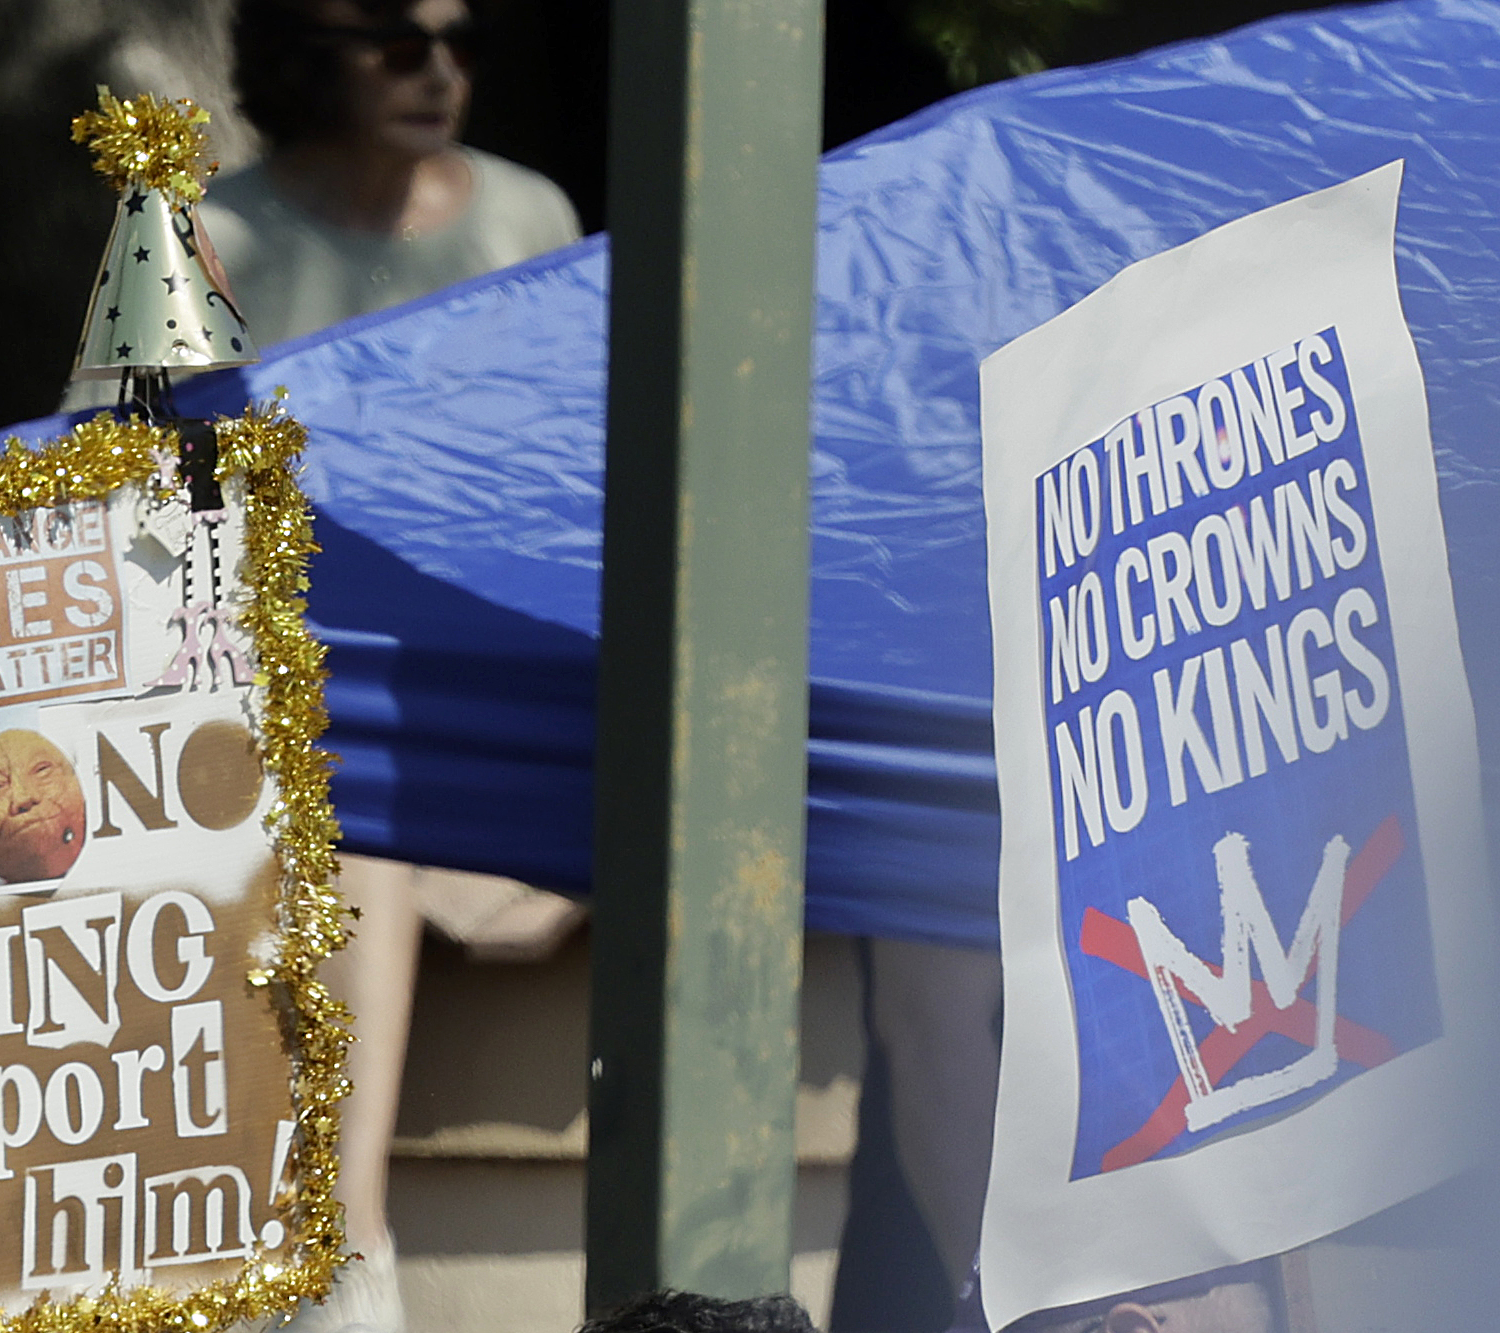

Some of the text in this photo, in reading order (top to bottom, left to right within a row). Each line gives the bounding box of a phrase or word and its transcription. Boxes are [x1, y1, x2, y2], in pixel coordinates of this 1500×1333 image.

[1043, 335, 1346, 578] NO THRONES
[1049, 459, 1367, 705] NO CROWNS
[92, 719, 265, 838] NO
[1055, 588, 1389, 861] NO KINGS
[25, 1120, 297, 1282] him!
